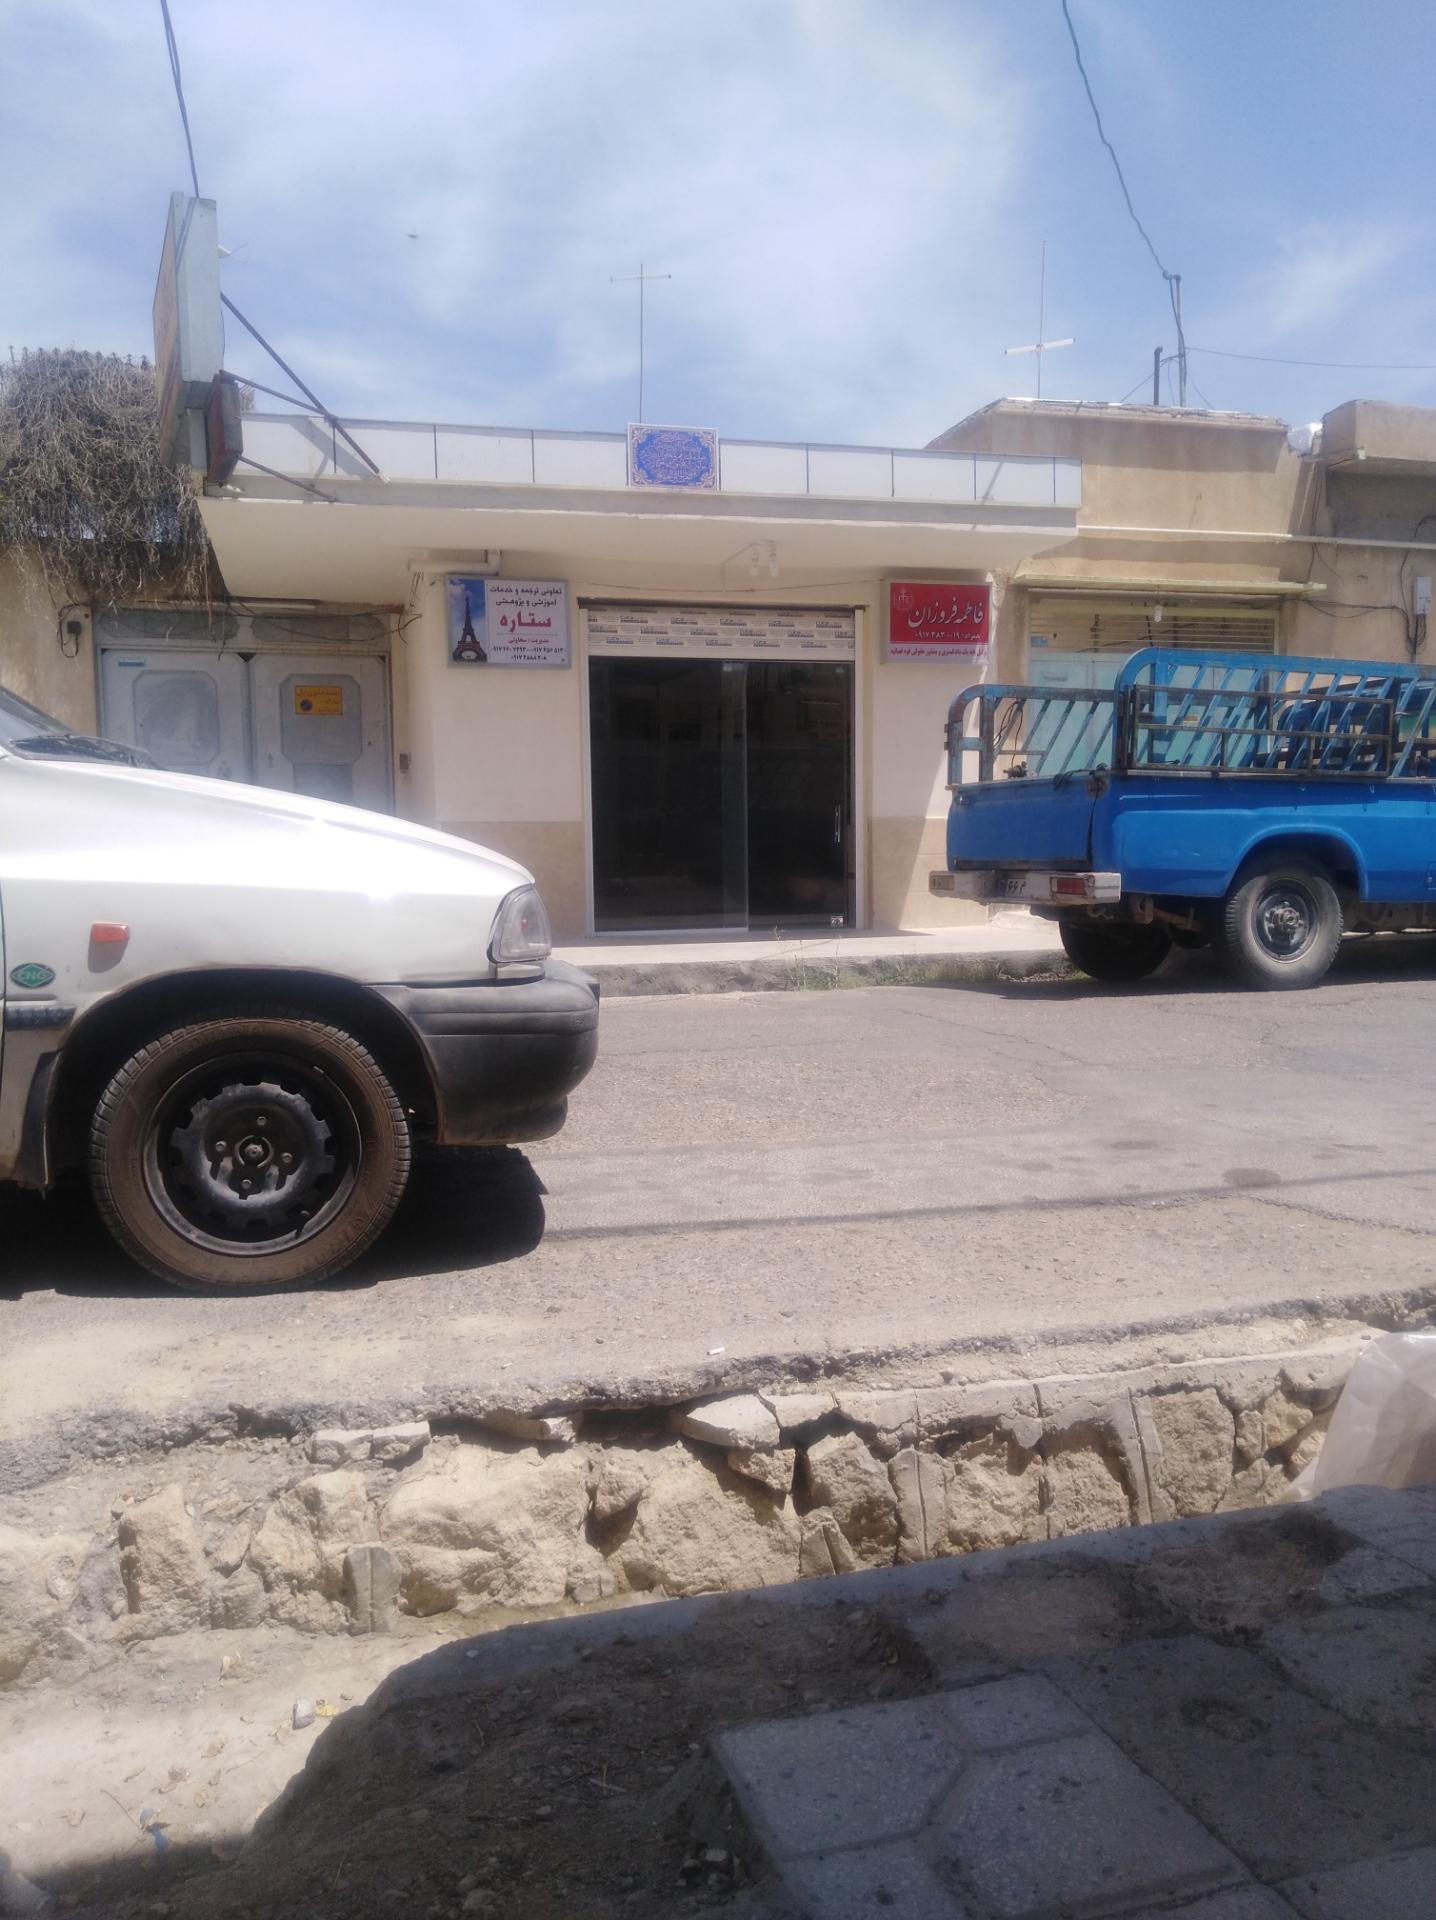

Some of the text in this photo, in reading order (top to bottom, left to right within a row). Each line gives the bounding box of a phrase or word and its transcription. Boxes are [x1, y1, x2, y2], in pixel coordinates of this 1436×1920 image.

[489, 585, 513, 593] خدمات
[521, 586, 539, 595] ترجمه
[496, 598, 524, 607] پژوهشی
[908, 596, 984, 628] فاطمه فروزان
[500, 610, 552, 633] ستاره
[16, 971, 48, 980] CNG
